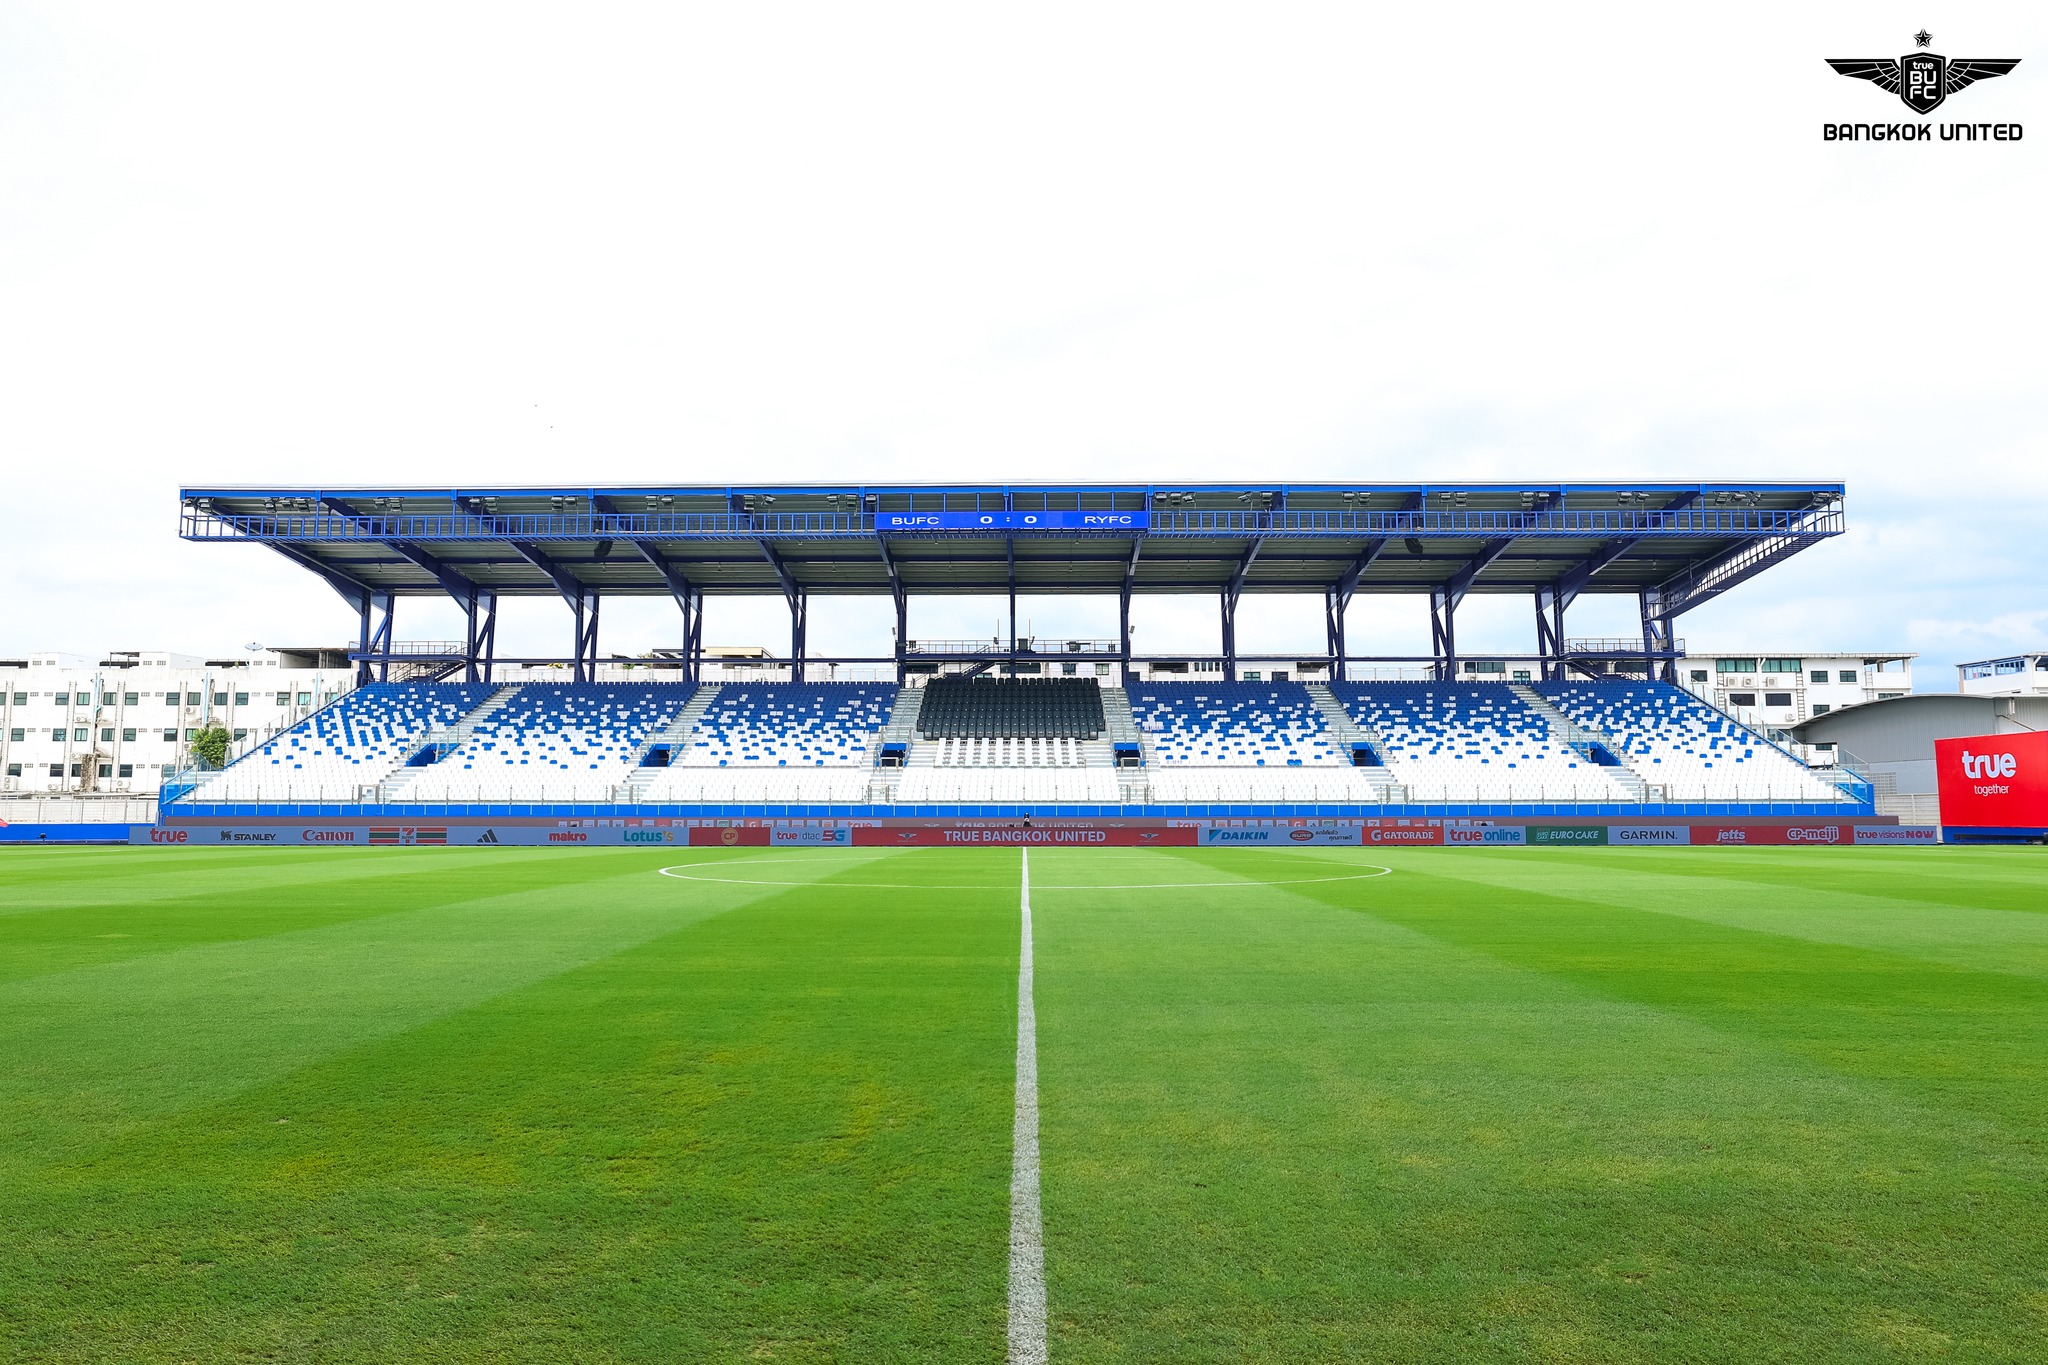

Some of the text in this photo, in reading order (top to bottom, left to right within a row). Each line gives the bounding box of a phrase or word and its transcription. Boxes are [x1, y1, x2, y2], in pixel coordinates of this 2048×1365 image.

[892, 516, 940, 525] BUFC
[980, 516, 993, 524] 0
[1024, 516, 1037, 524] 0
[1084, 516, 1132, 524] RYFC
[1962, 750, 2016, 779] true
[1974, 784, 2010, 797] together
[150, 828, 188, 842] true
[302, 830, 354, 842] Canon
[549, 831, 587, 842] makro
[624, 830, 674, 842] Lotus's
[776, 830, 846, 841] true dtac 5G
[944, 831, 1106, 842] TRUE BANGKOK UNITED
[1221, 832, 1268, 840] DAIKIN
[1384, 831, 1434, 839] GATORADE
[1450, 829, 1520, 841] true online
[1550, 831, 1574, 839] EURO
[1575, 831, 1599, 839] CAKE
[1717, 829, 1745, 841] jetts
[1787, 826, 1839, 843] CP-meiji
[1857, 830, 1934, 838] true visions NOW
